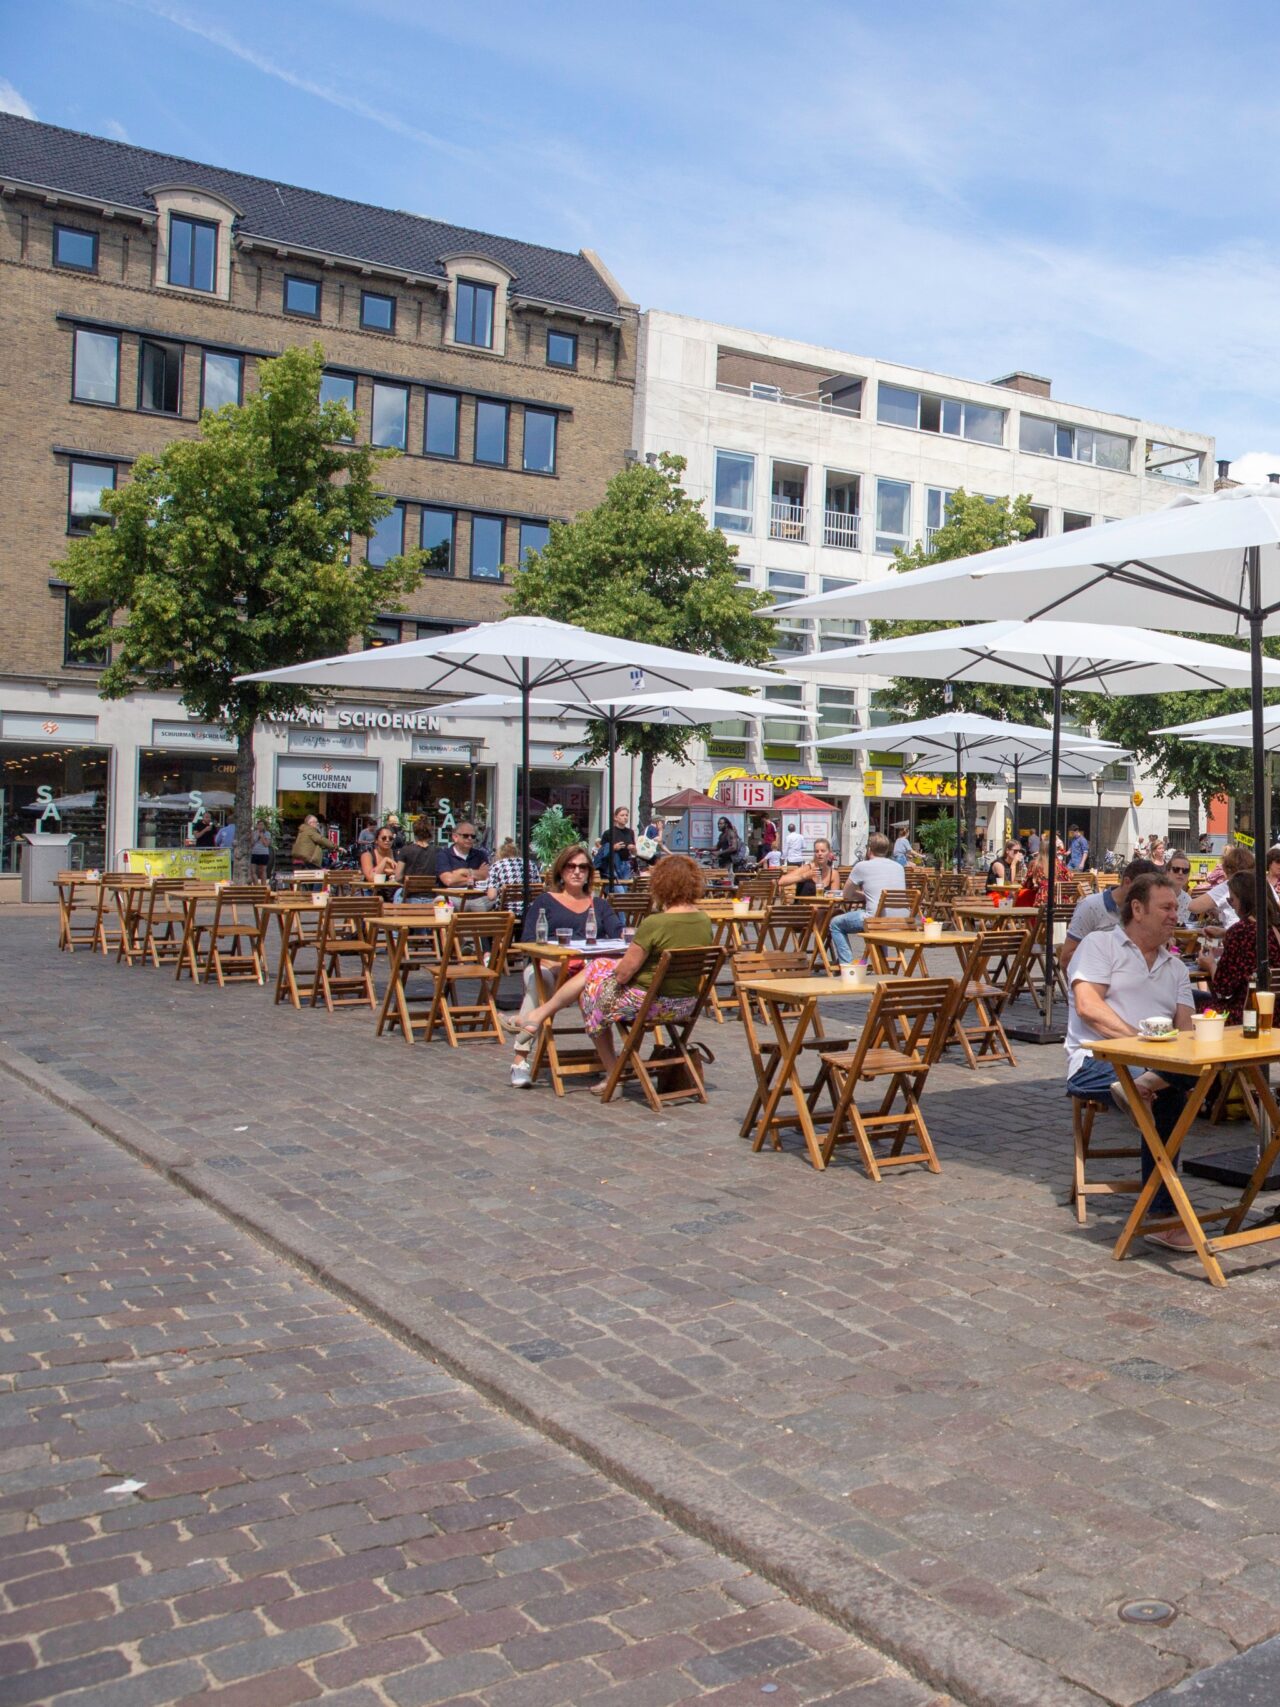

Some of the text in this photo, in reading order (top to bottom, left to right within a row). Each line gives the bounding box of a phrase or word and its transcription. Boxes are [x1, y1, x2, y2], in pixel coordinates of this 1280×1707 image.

[339, 711, 440, 731] SCHOENEN
[302, 773, 352, 782] SCHUURMAN
[306, 781, 347, 790] SCHOENEN
[720, 783, 731, 805] ijs
[743, 783, 765, 805] ijs
